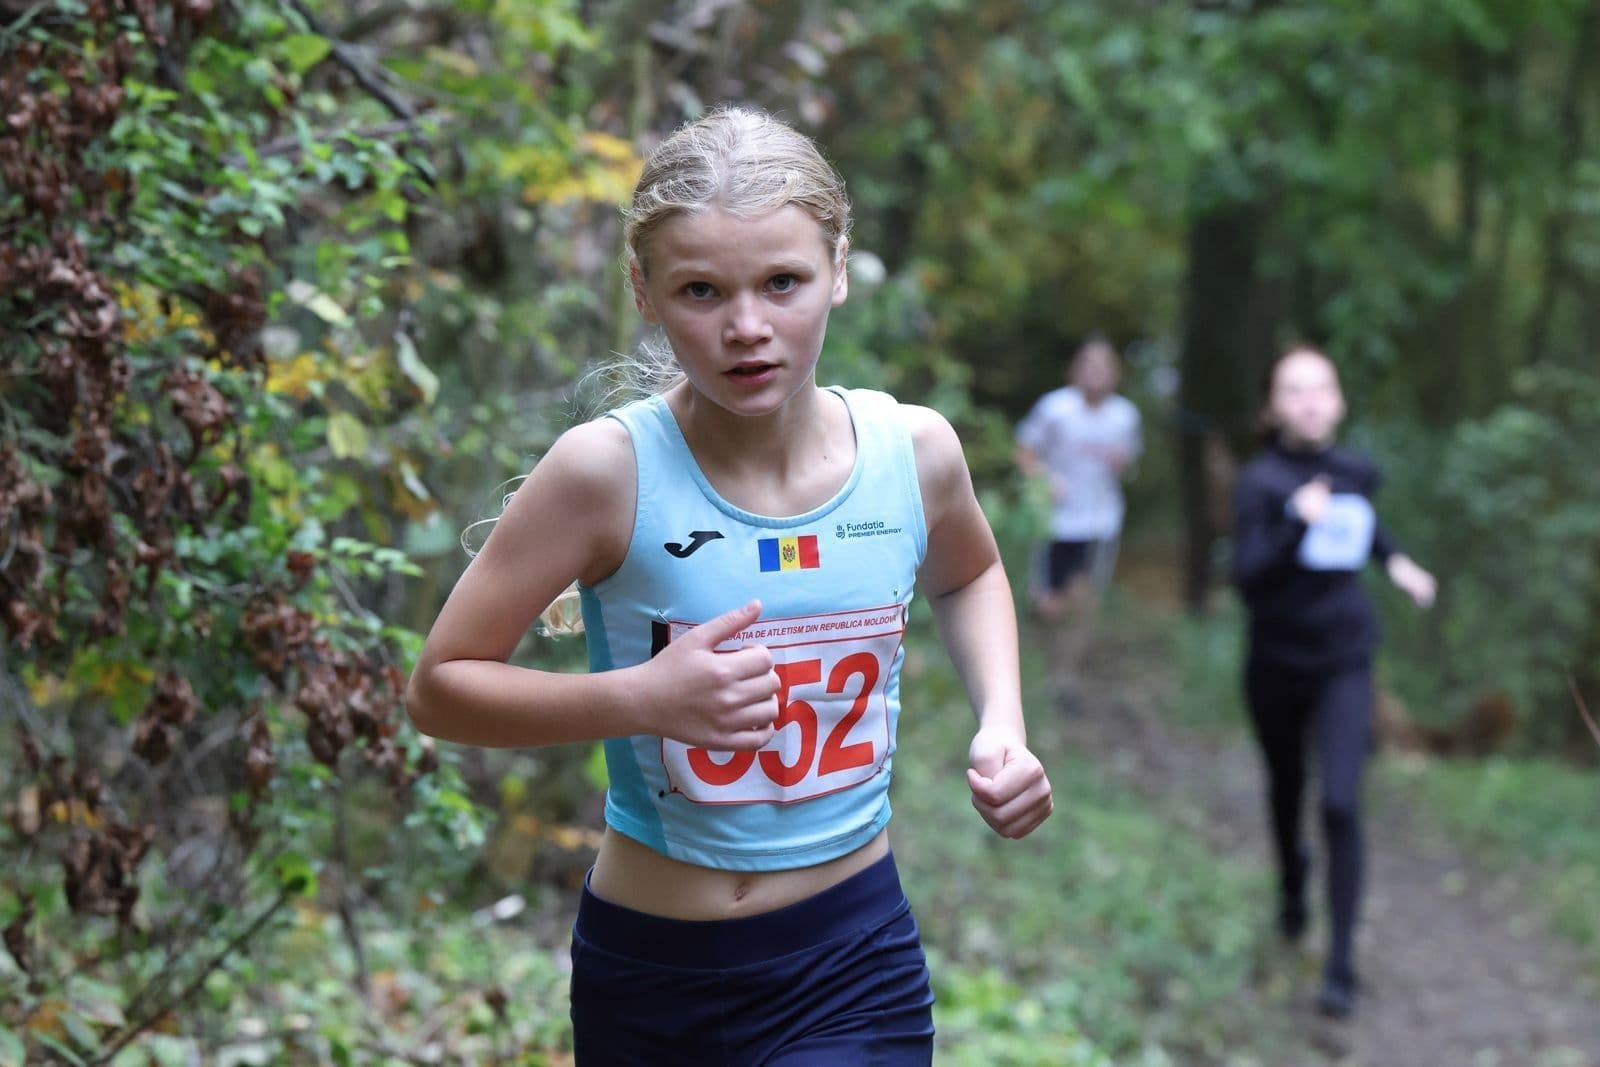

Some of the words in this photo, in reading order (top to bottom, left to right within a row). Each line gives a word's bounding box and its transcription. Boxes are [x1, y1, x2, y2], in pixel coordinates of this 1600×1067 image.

[848, 530, 875, 538] PREMIER
[755, 630, 766, 639] DE
[767, 625, 804, 637] ATLETISM
[805, 624, 819, 633] DIN
[820, 620, 862, 631] REPUBLICA
